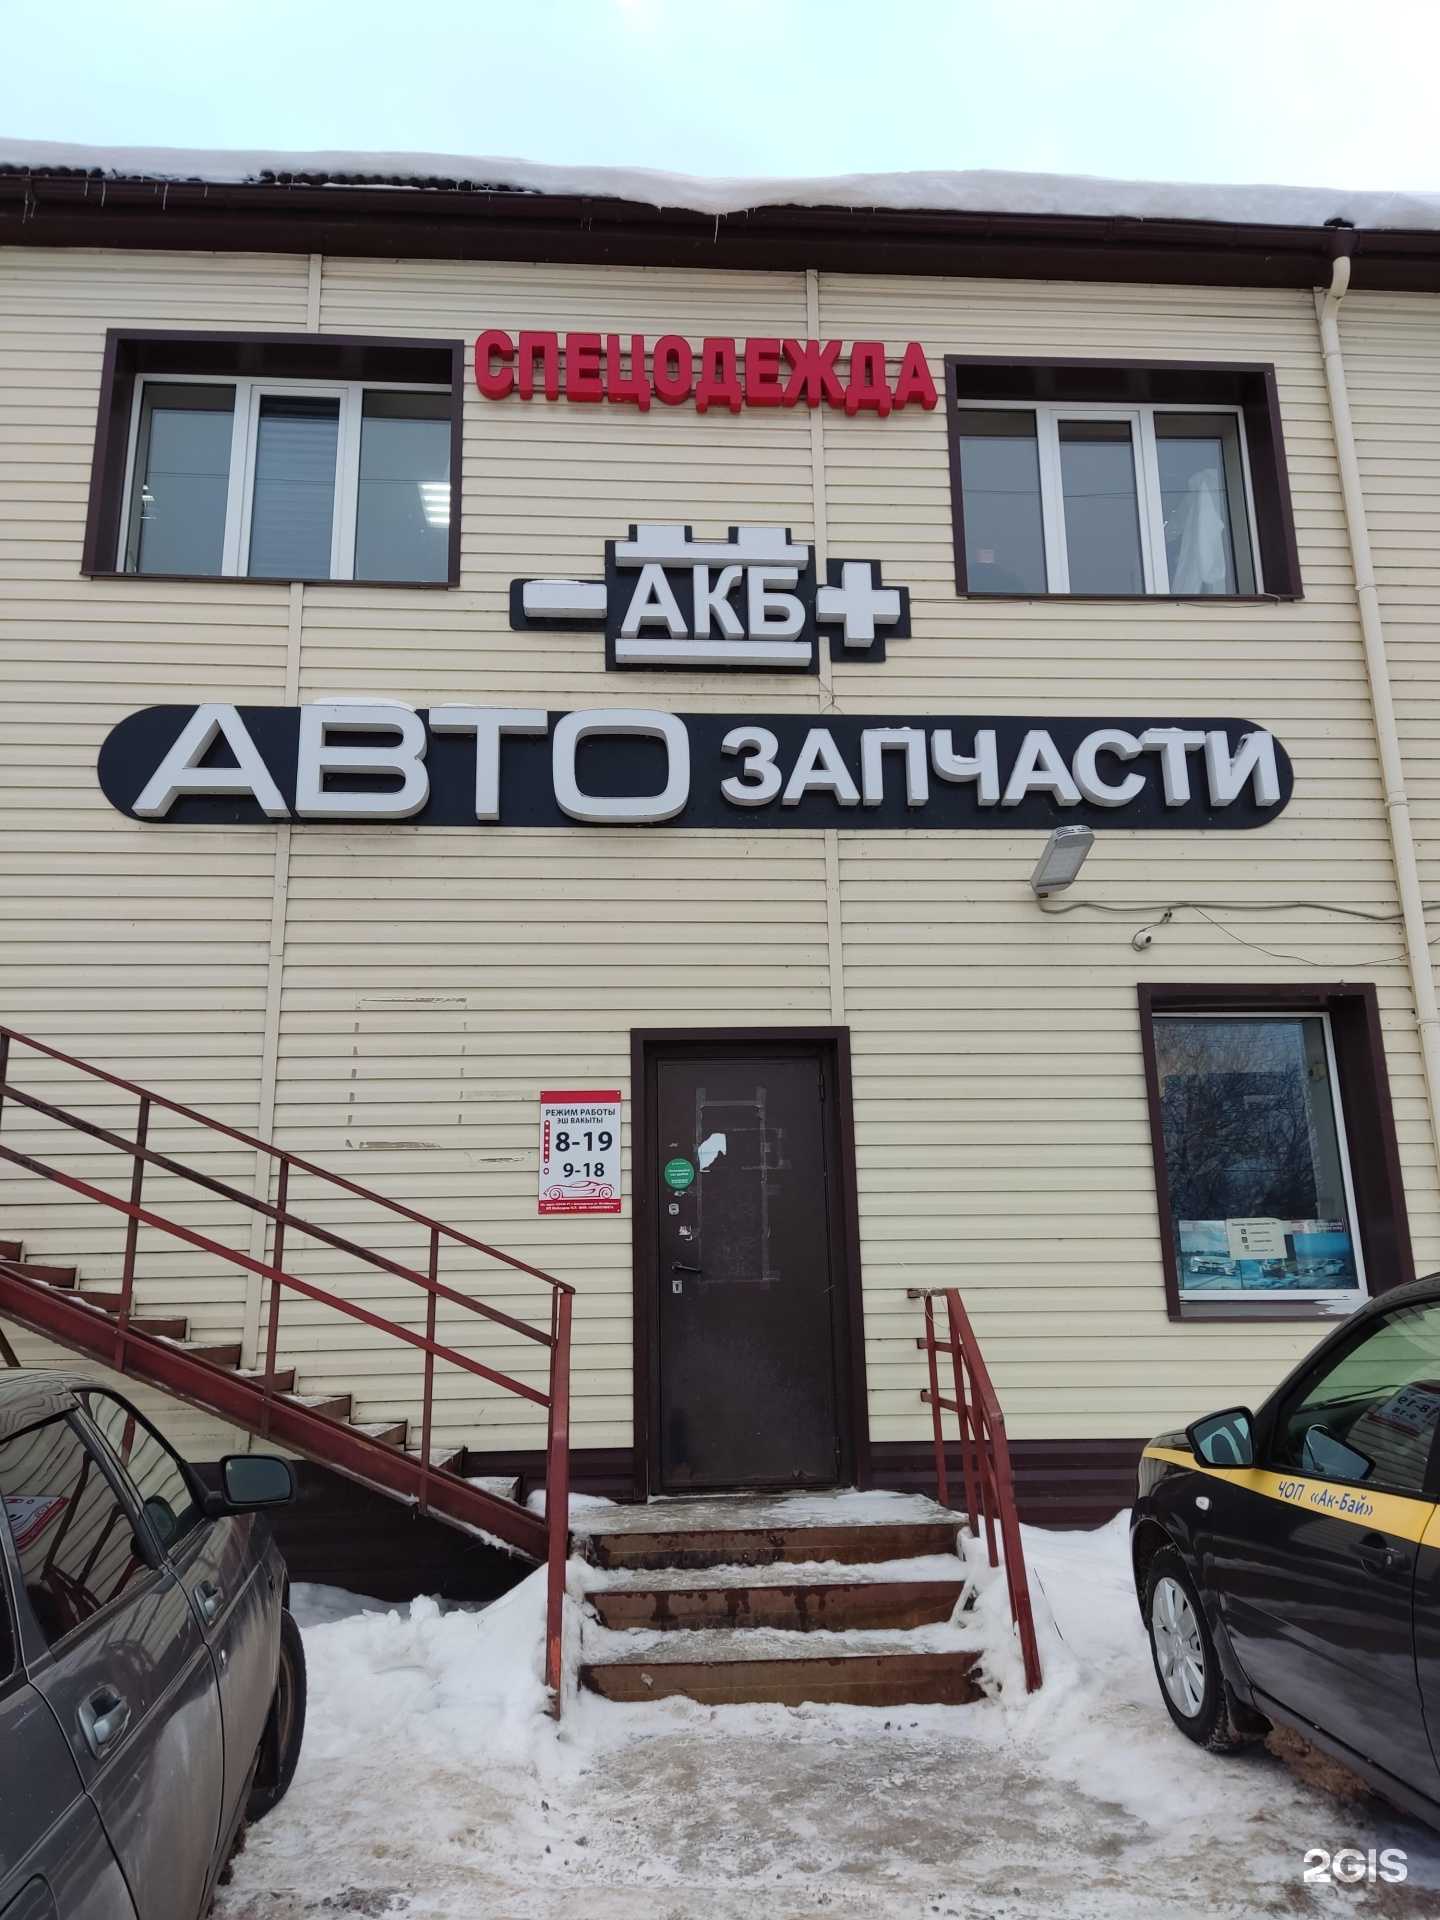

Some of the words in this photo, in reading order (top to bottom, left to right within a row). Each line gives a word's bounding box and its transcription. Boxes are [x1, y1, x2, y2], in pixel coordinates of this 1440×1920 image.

[474, 329, 938, 417] СПЕЦОДЕЖДА
[620, 563, 806, 641] АКБ
[131, 700, 690, 823] АВТО
[721, 726, 1280, 807] ЗАПЧАСТИ
[545, 1109, 578, 1117] РЕЖИМ
[580, 1108, 616, 1116] РАБОТЫ
[555, 1131, 613, 1152] 8-19
[563, 1162, 605, 1178] 9-18
[1278, 1481, 1305, 1501] ЧОП
[1310, 1488, 1374, 1516] «Ак-Бай»
